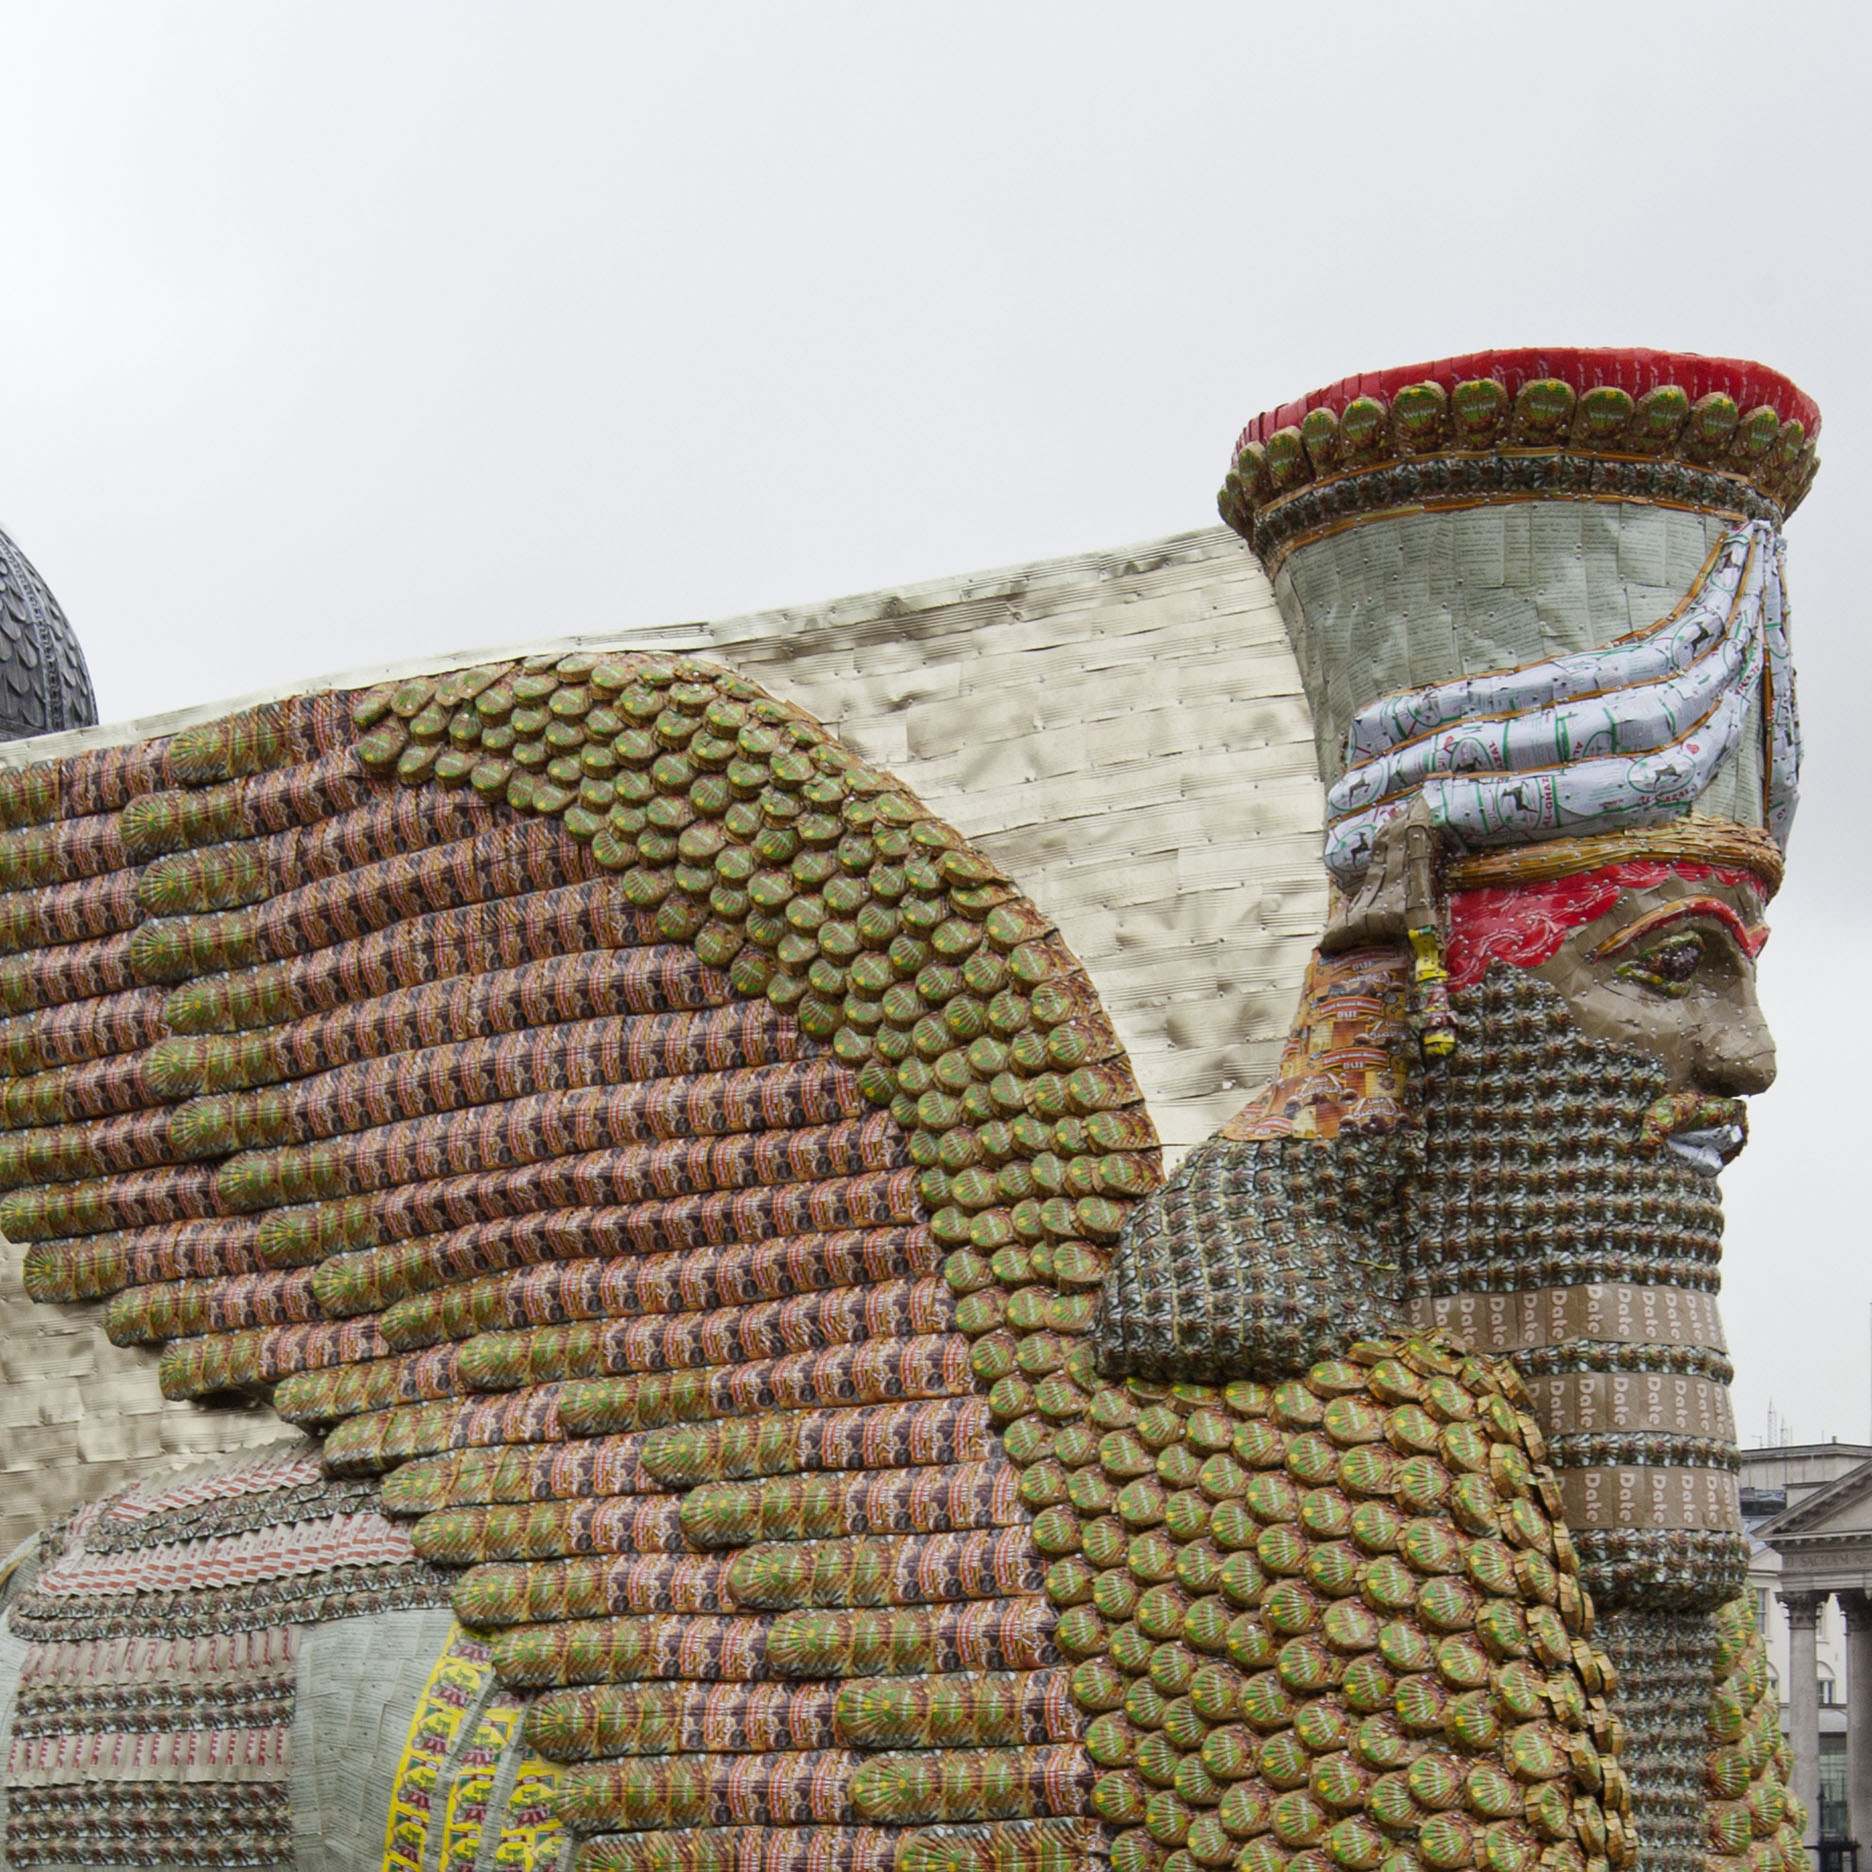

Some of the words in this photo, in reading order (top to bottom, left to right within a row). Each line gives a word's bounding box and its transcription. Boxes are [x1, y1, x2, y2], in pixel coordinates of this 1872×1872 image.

[1542, 776, 1553, 826] AL-GHAZ
[1411, 1299, 1426, 1330] Dat
[1490, 1297, 1507, 1346] Date
[1524, 1293, 1538, 1342] Date
[1552, 1290, 1567, 1339] Date
[1586, 1285, 1603, 1333] Date
[1618, 1288, 1633, 1336] Date
[1642, 1292, 1659, 1338] Date
[1665, 1293, 1681, 1339] Date
[1686, 1295, 1703, 1341] Date
[1551, 1381, 1566, 1430] Date
[1580, 1379, 1596, 1428] Date
[1614, 1377, 1629, 1426] Date
[1648, 1377, 1663, 1425] Date
[1674, 1381, 1689, 1428] Date
[1585, 1473, 1603, 1522] Date
[1620, 1472, 1635, 1522] Date
[1653, 1475, 1667, 1523] Date
[1682, 1475, 1696, 1523] Date
[1706, 1476, 1720, 1523] Date
